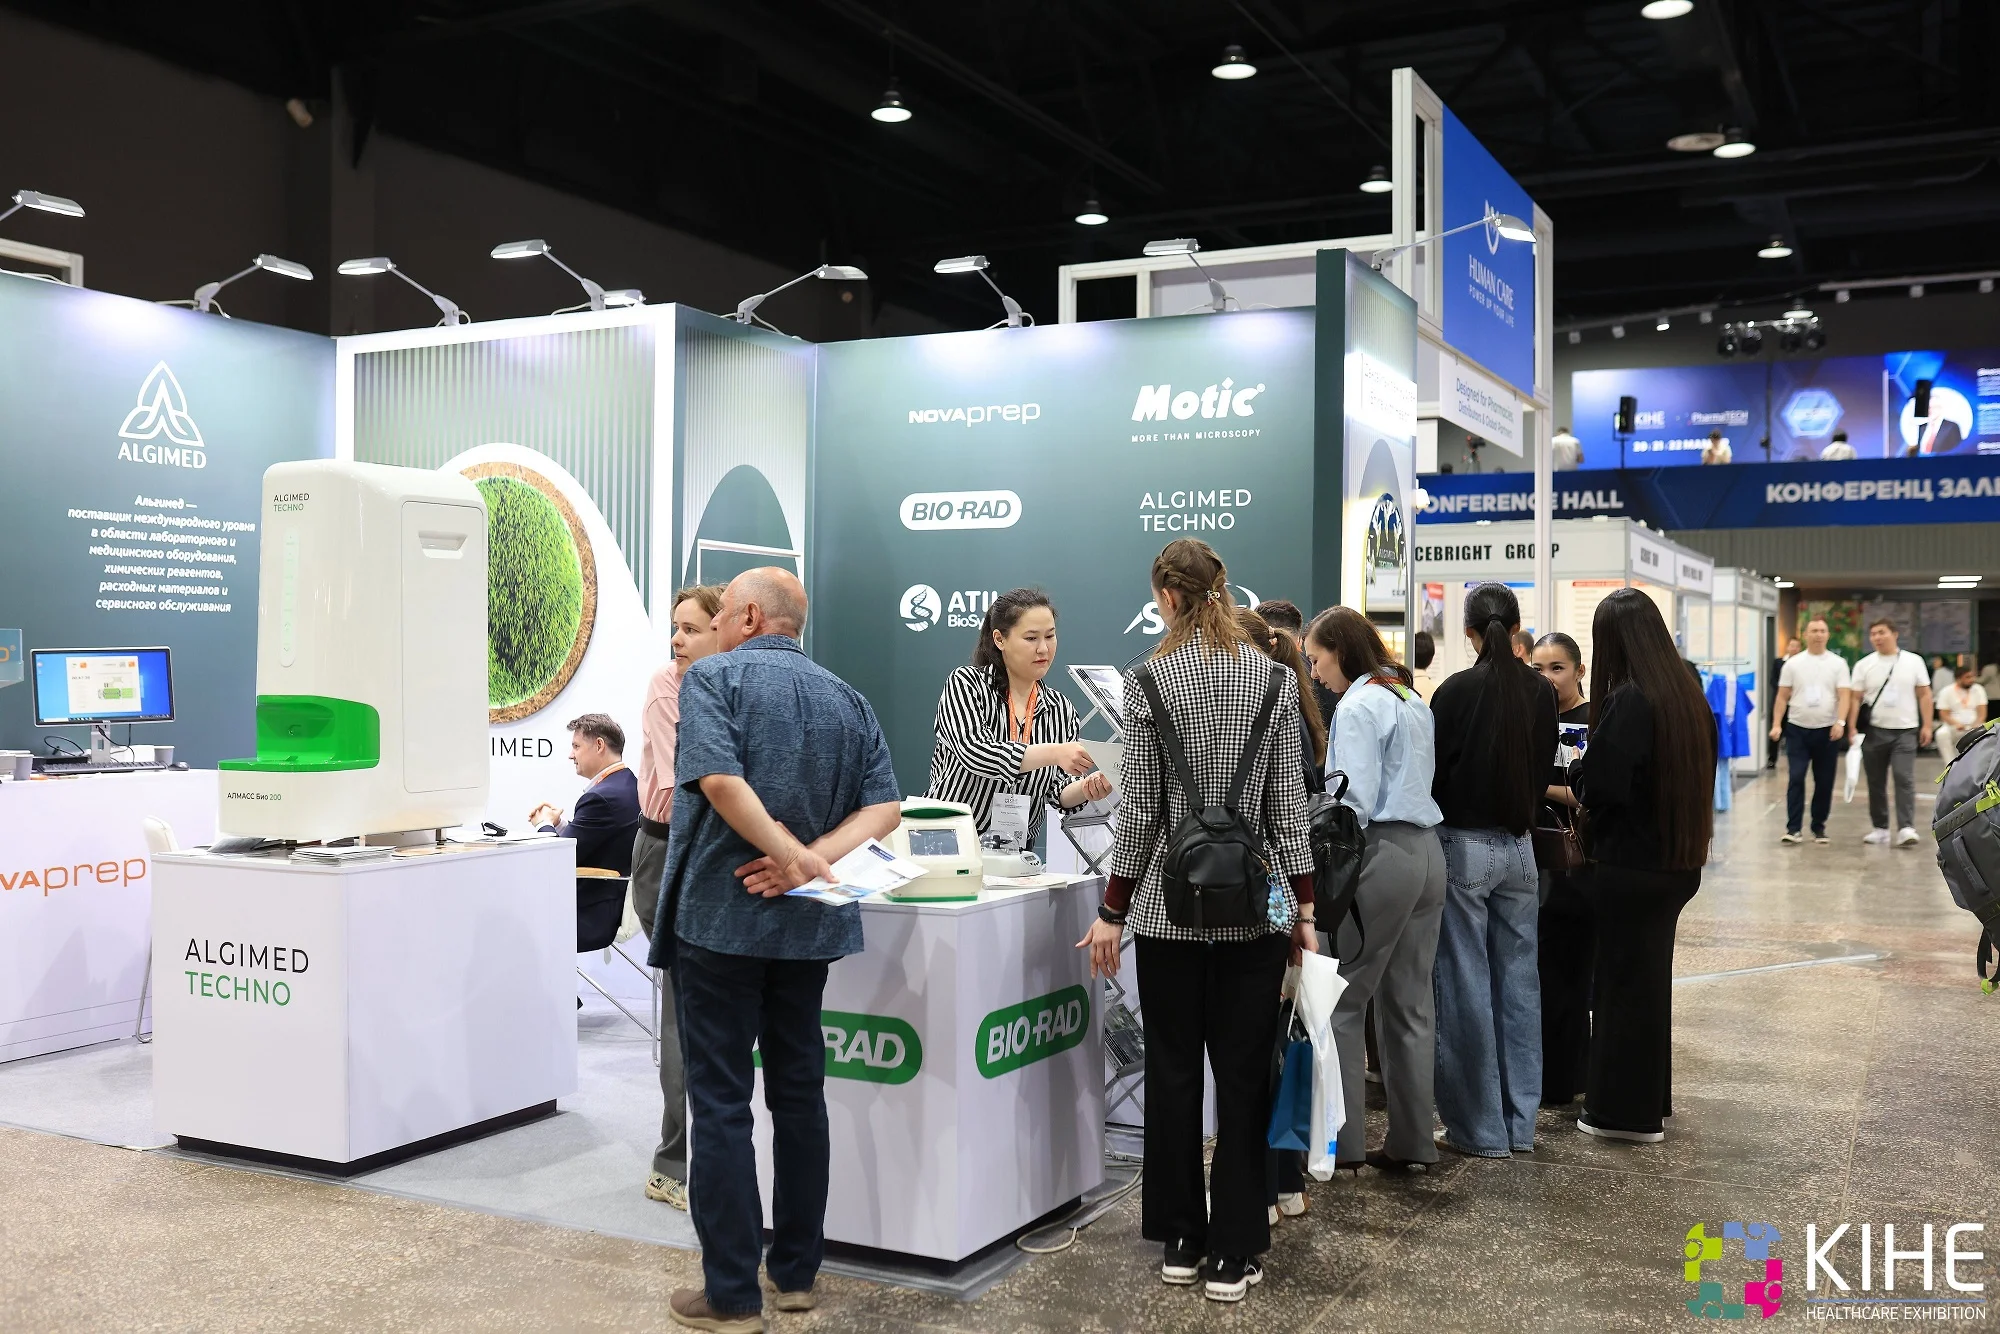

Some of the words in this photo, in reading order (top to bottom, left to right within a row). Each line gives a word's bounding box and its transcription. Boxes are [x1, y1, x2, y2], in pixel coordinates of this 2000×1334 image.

[1469, 254, 1496, 296] HUMAN
[1497, 278, 1514, 311] CARE
[1457, 377, 1479, 403] Designed
[1131, 434, 1159, 442] MORE
[1164, 432, 1190, 441] THAN
[1195, 429, 1261, 439] MICROSCOPY
[117, 442, 207, 469] ALGIMED
[273, 493, 310, 502] ALGIMED
[1140, 488, 1252, 510] ALGIMED
[1766, 478, 1933, 503] КОНФЕРЕНЦ
[135, 494, 185, 510] Альгимед
[273, 503, 304, 512] TECHNO
[911, 499, 1012, 521] BIO-RAD
[1417, 492, 1560, 514] ONFERENE
[1562, 490, 1624, 511] HALL
[68, 508, 132, 523] поставщик
[134, 513, 221, 529] международного
[221, 520, 256, 533] уровня
[1140, 512, 1235, 532] TECHNO
[91, 528, 98, 538] в
[101, 526, 147, 541] области
[149, 531, 227, 547] лабораторного
[230, 538, 236, 547] и
[89, 544, 164, 559] медицинского
[166, 549, 237, 565] оборудования,
[1415, 545, 1492, 562] CEBRIGHT
[1505, 543, 1560, 560] GROP
[104, 564, 165, 576] химических
[167, 567, 223, 580] реагентов,
[99, 580, 156, 593] расходных
[158, 583, 219, 596] материалов
[222, 587, 228, 596] и
[95, 599, 157, 611] сервисного
[159, 599, 231, 613] обслуживания
[948, 614, 985, 630] BioSy
[492, 737, 553, 758] IMED
[227, 792, 255, 800] АЛМАСС
[270, 793, 282, 801] 200
[0, 857, 147, 897] VAprep
[184, 938, 310, 974] ALGIMED
[184, 970, 291, 1006] TECHNO
[987, 999, 1083, 1066] BIO-RAD
[823, 1025, 906, 1069] RAD
